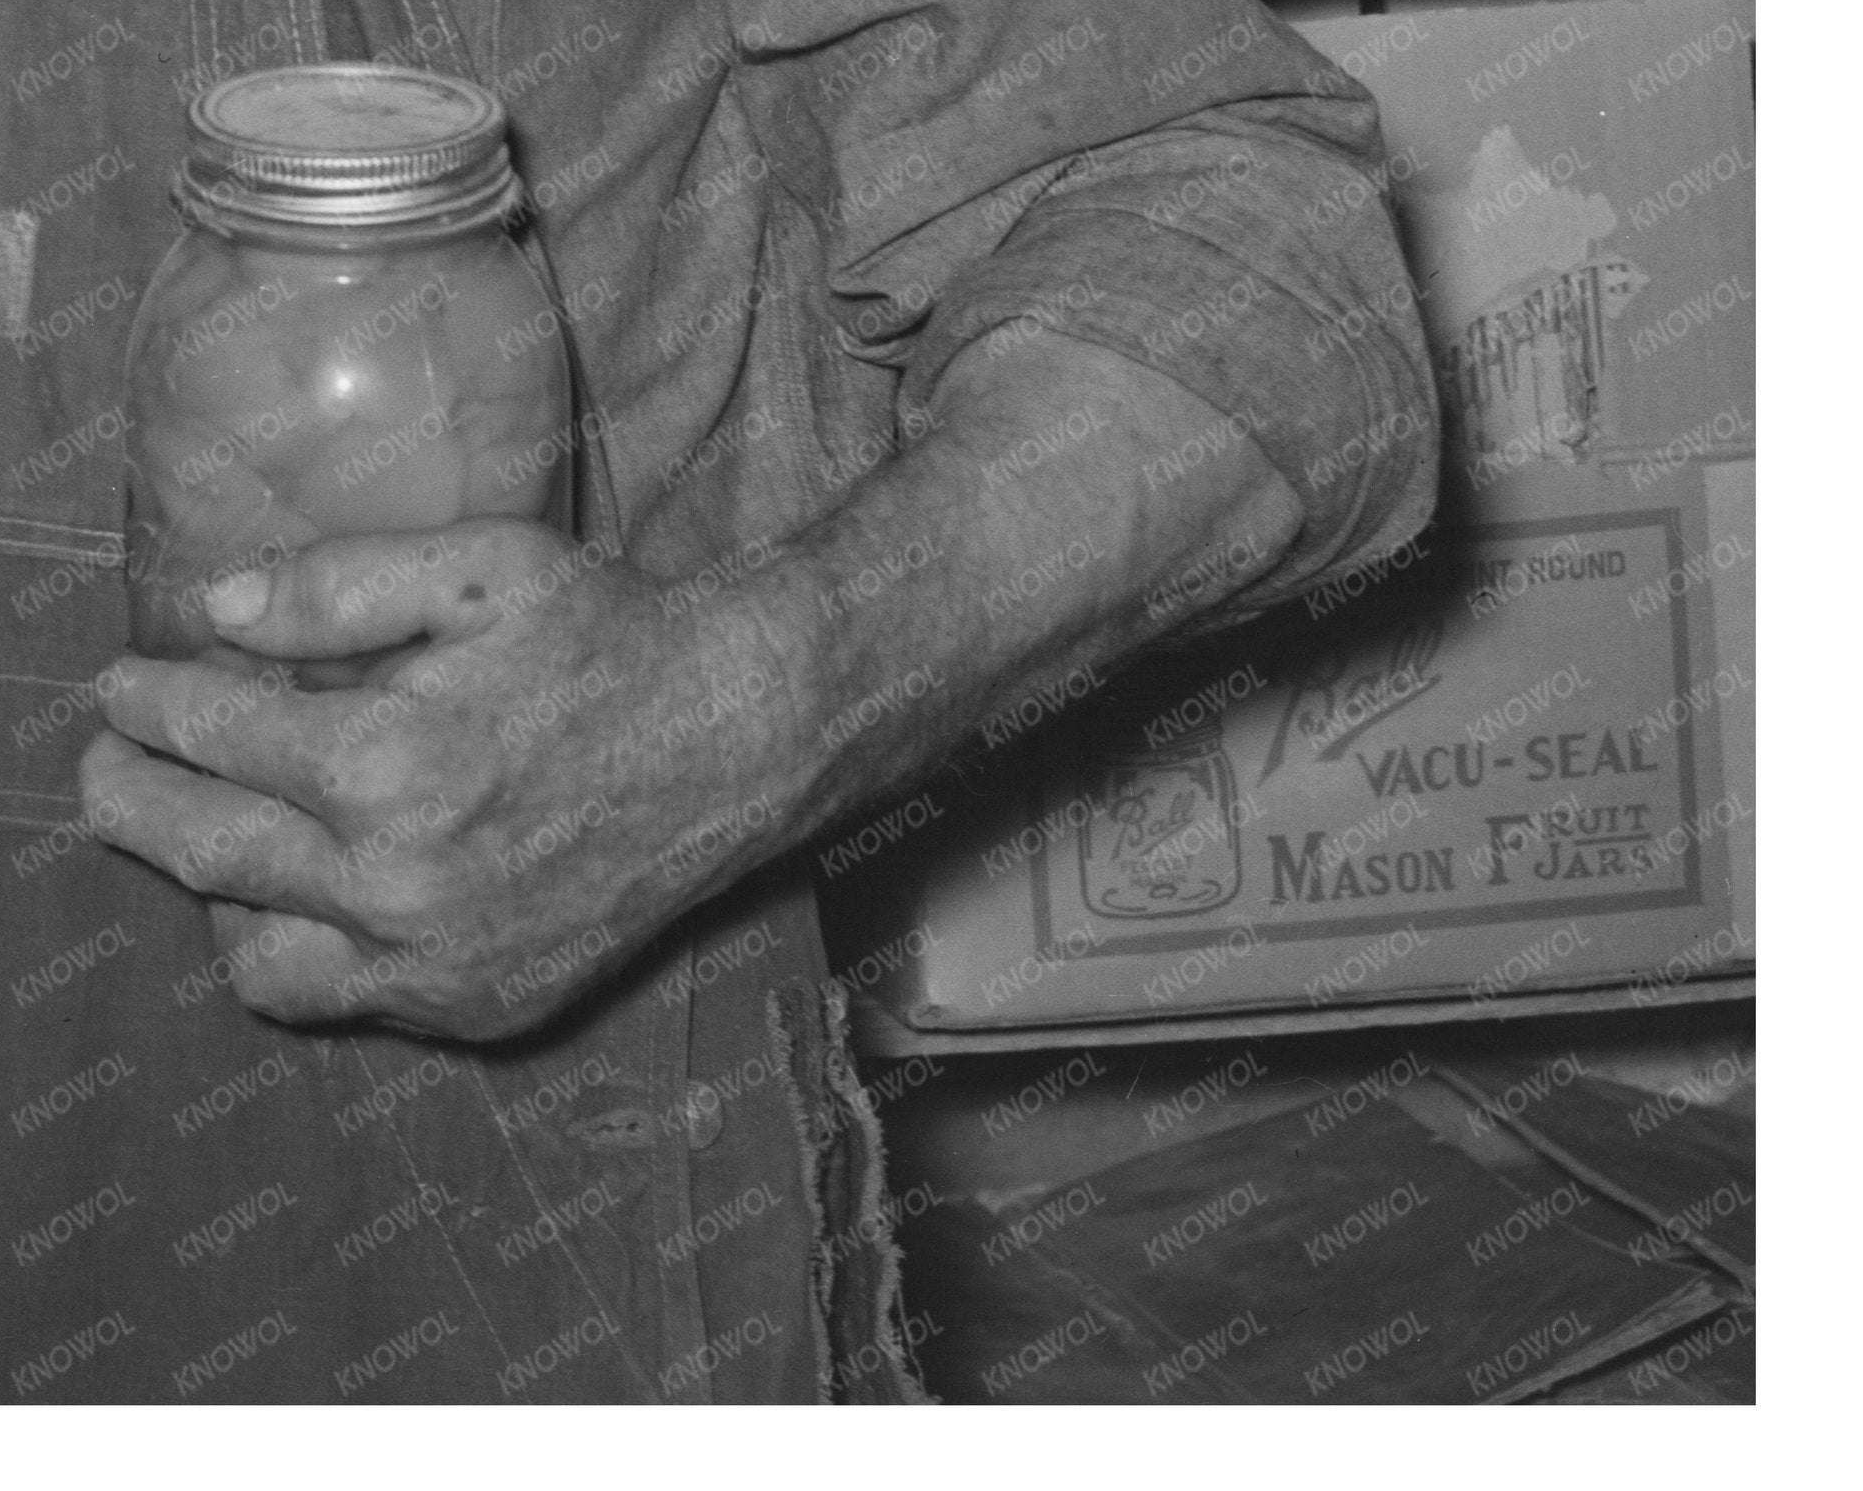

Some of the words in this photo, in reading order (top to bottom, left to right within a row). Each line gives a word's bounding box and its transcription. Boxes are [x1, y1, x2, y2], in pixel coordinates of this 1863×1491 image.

[1526, 550, 1627, 585] ROUND
[1256, 616, 1445, 789] Ball
[1110, 786, 1196, 861] Ball
[1266, 830, 1456, 905] MASON
[1485, 804, 1650, 887] FRUIT
[1533, 843, 1654, 881] JARS
